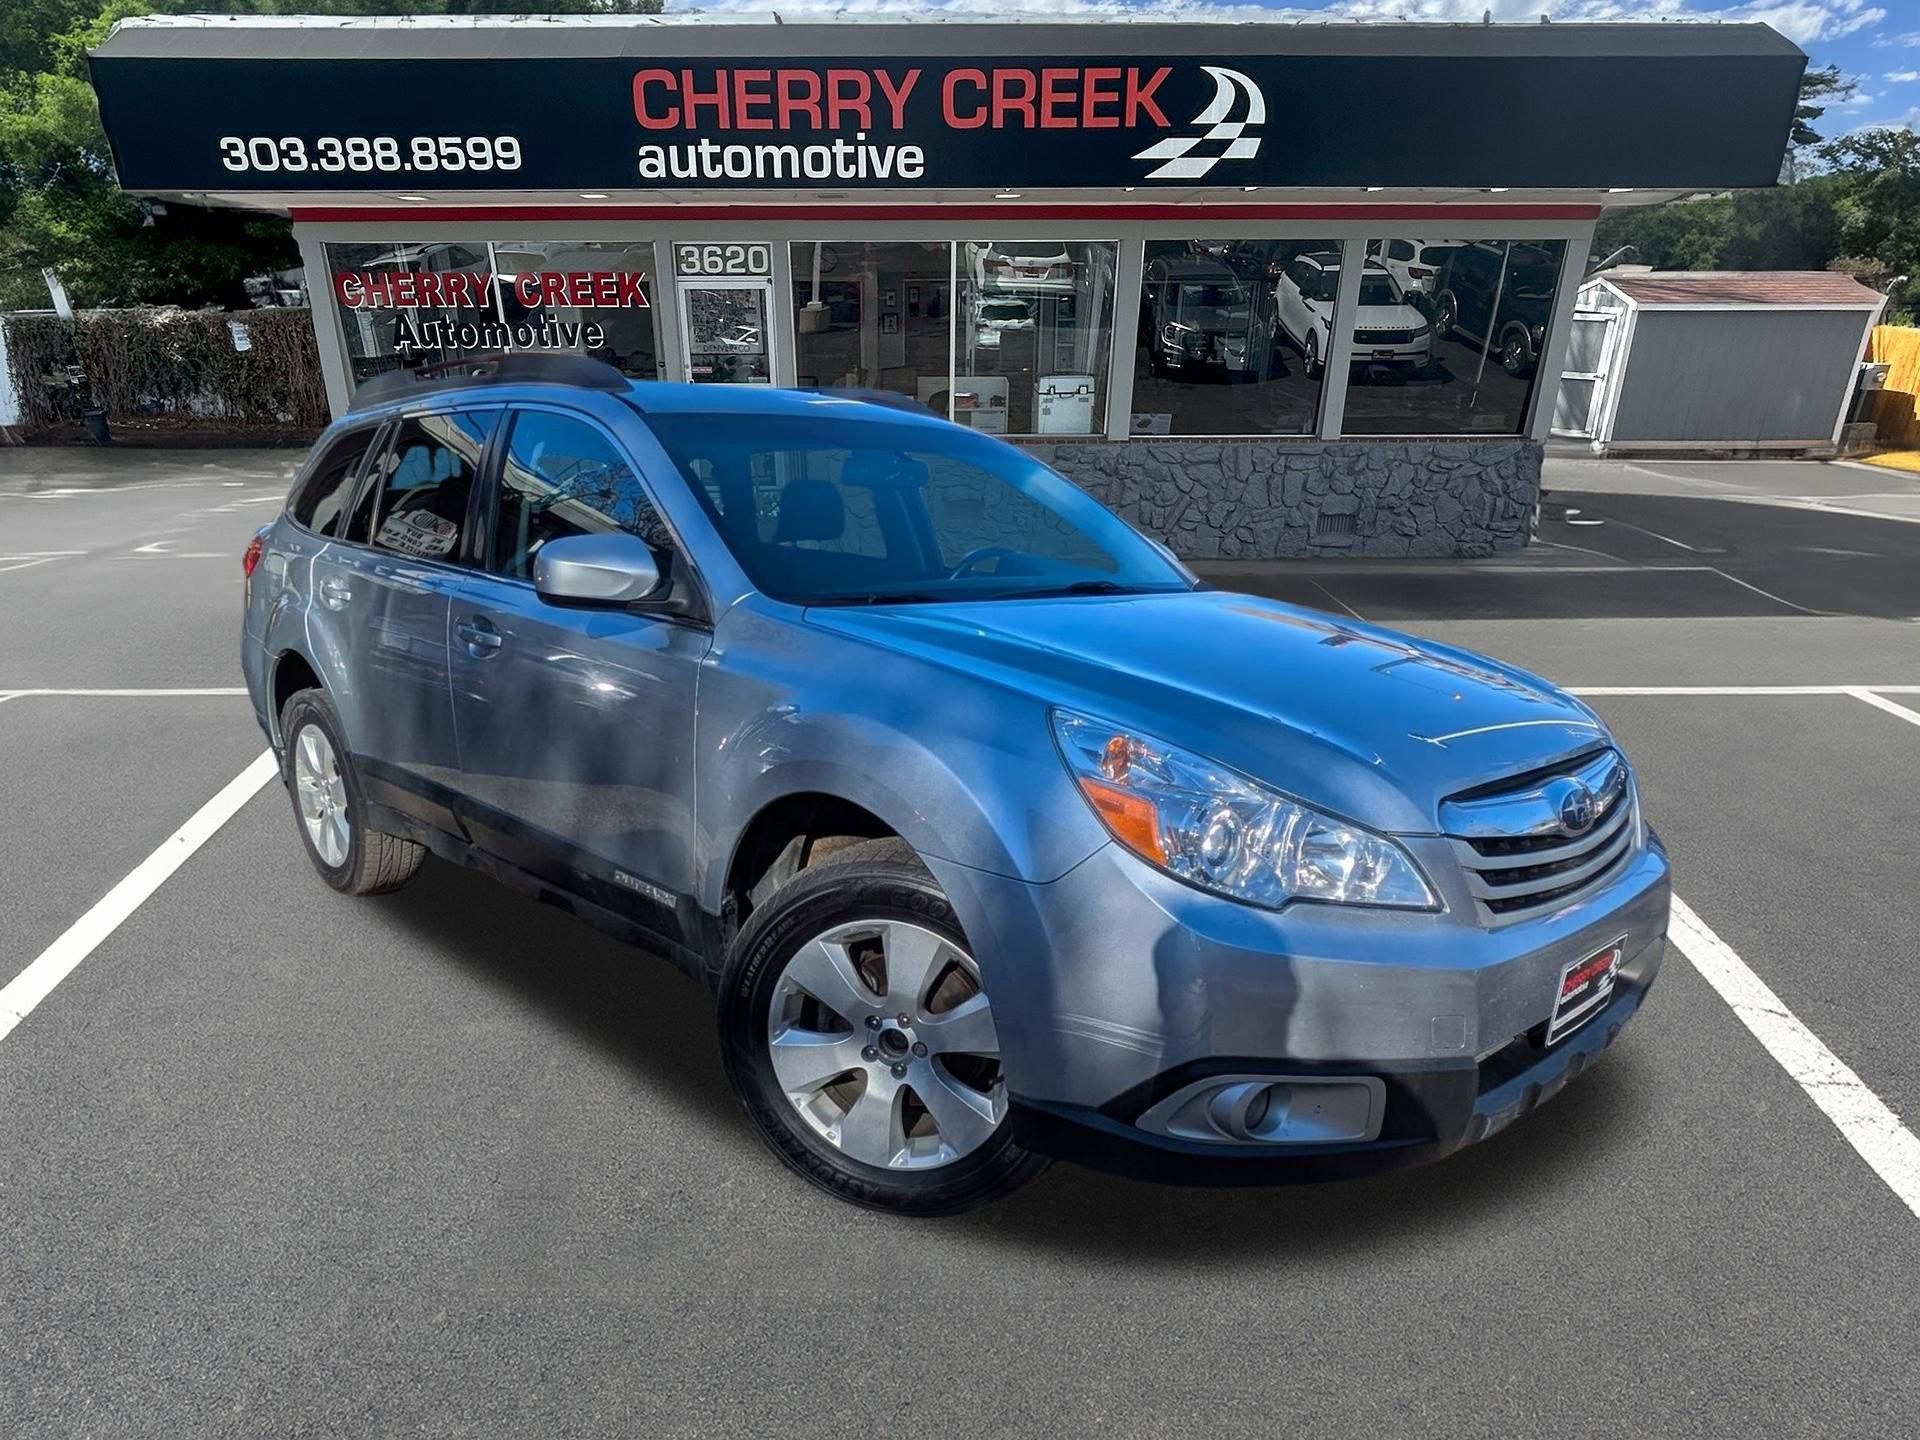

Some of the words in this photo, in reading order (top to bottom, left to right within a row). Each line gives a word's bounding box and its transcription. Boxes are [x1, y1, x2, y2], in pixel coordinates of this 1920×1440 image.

[632, 68, 921, 130] CHERRY
[942, 66, 1173, 129] CREEK
[219, 135, 523, 172] 303.388.8599
[638, 132, 925, 180] automotive
[680, 245, 769, 274] 3620
[335, 271, 493, 309] CHERRY
[514, 271, 651, 309] CREEK
[393, 313, 607, 351] Automotive
